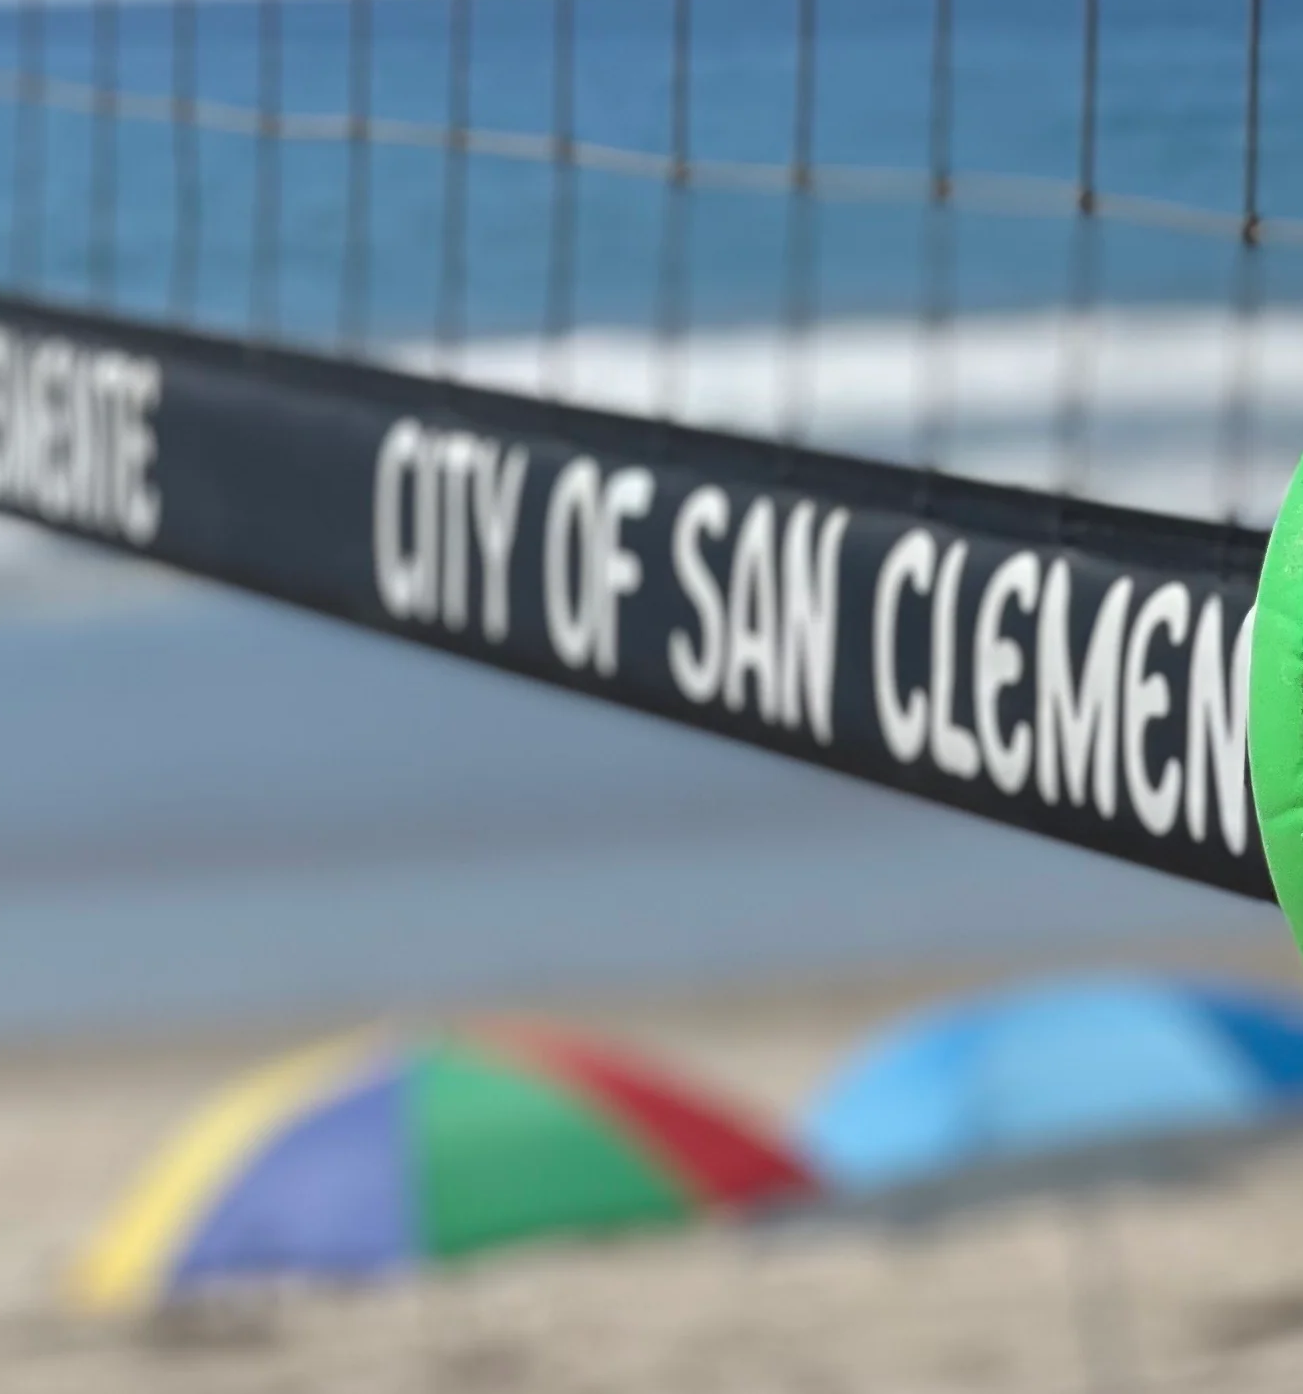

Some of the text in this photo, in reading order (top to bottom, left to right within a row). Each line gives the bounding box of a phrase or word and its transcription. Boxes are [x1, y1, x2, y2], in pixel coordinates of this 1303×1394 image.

[372, 415, 1257, 855] CITY OF SAN CLEMEN
